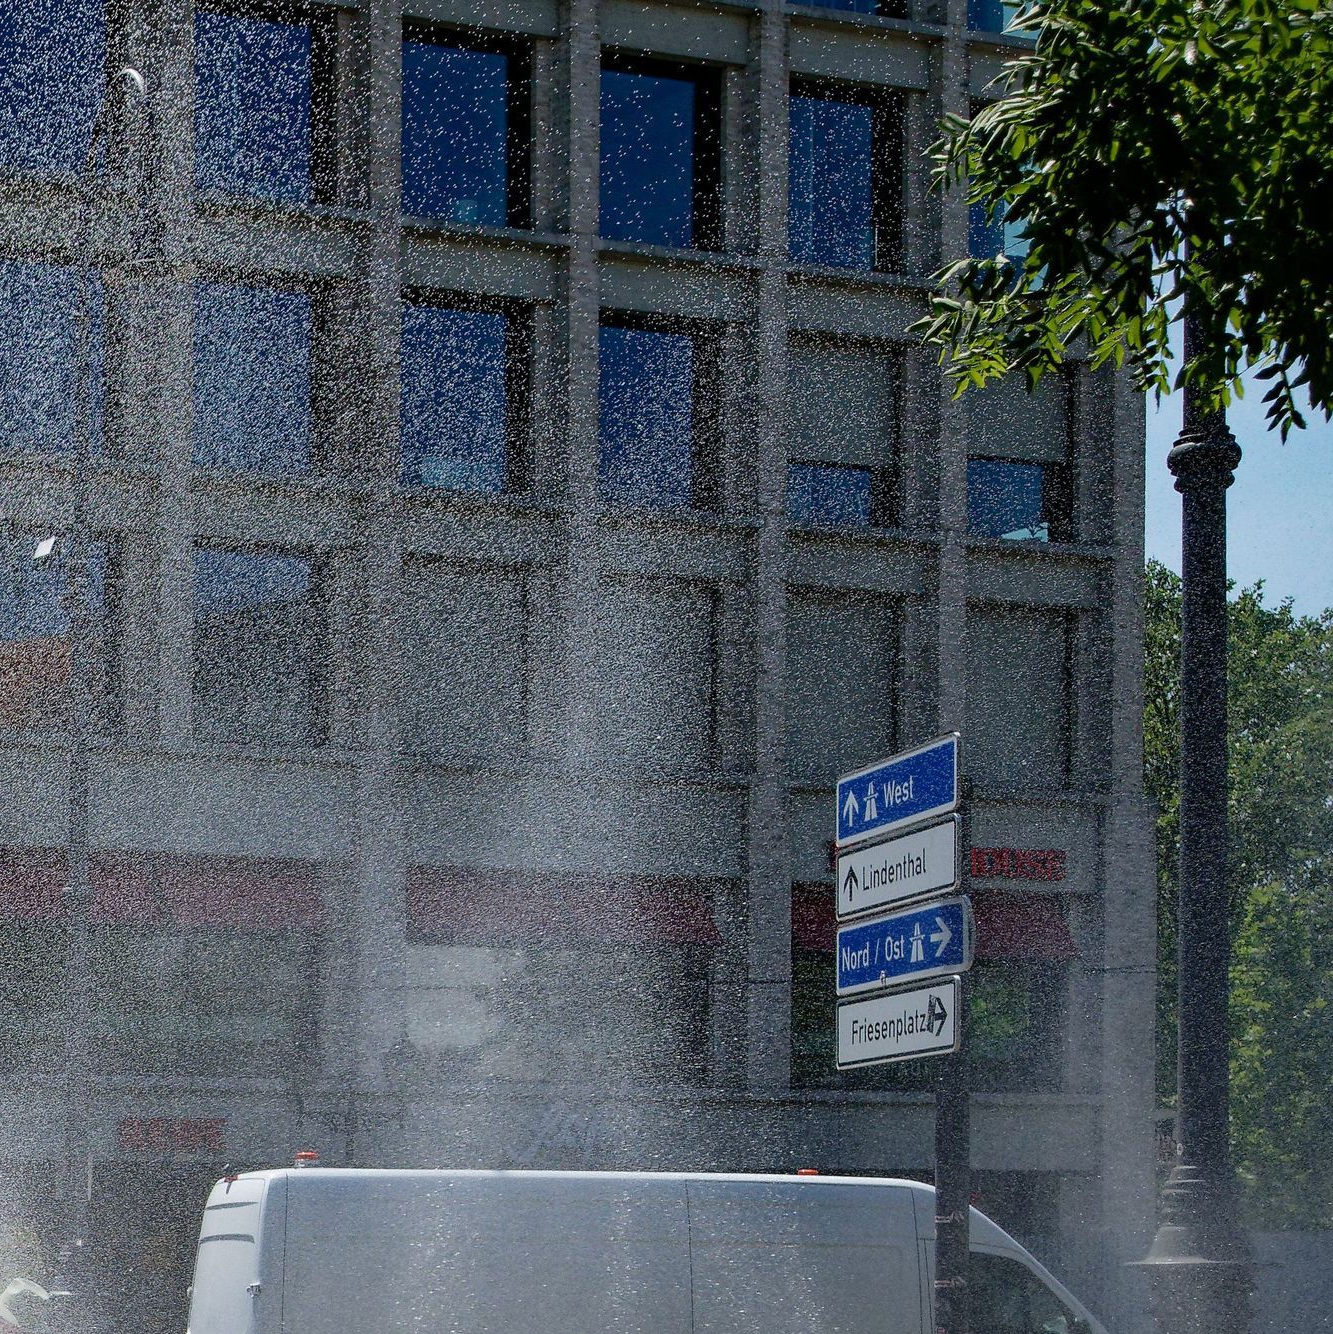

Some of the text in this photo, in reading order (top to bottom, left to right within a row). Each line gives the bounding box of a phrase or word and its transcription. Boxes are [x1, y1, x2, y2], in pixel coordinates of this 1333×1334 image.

[883, 776, 914, 809] West
[861, 847, 927, 892] Lindenthal
[841, 934, 905, 972] Nord / Ost
[850, 1004, 928, 1047] Friesenplatz
